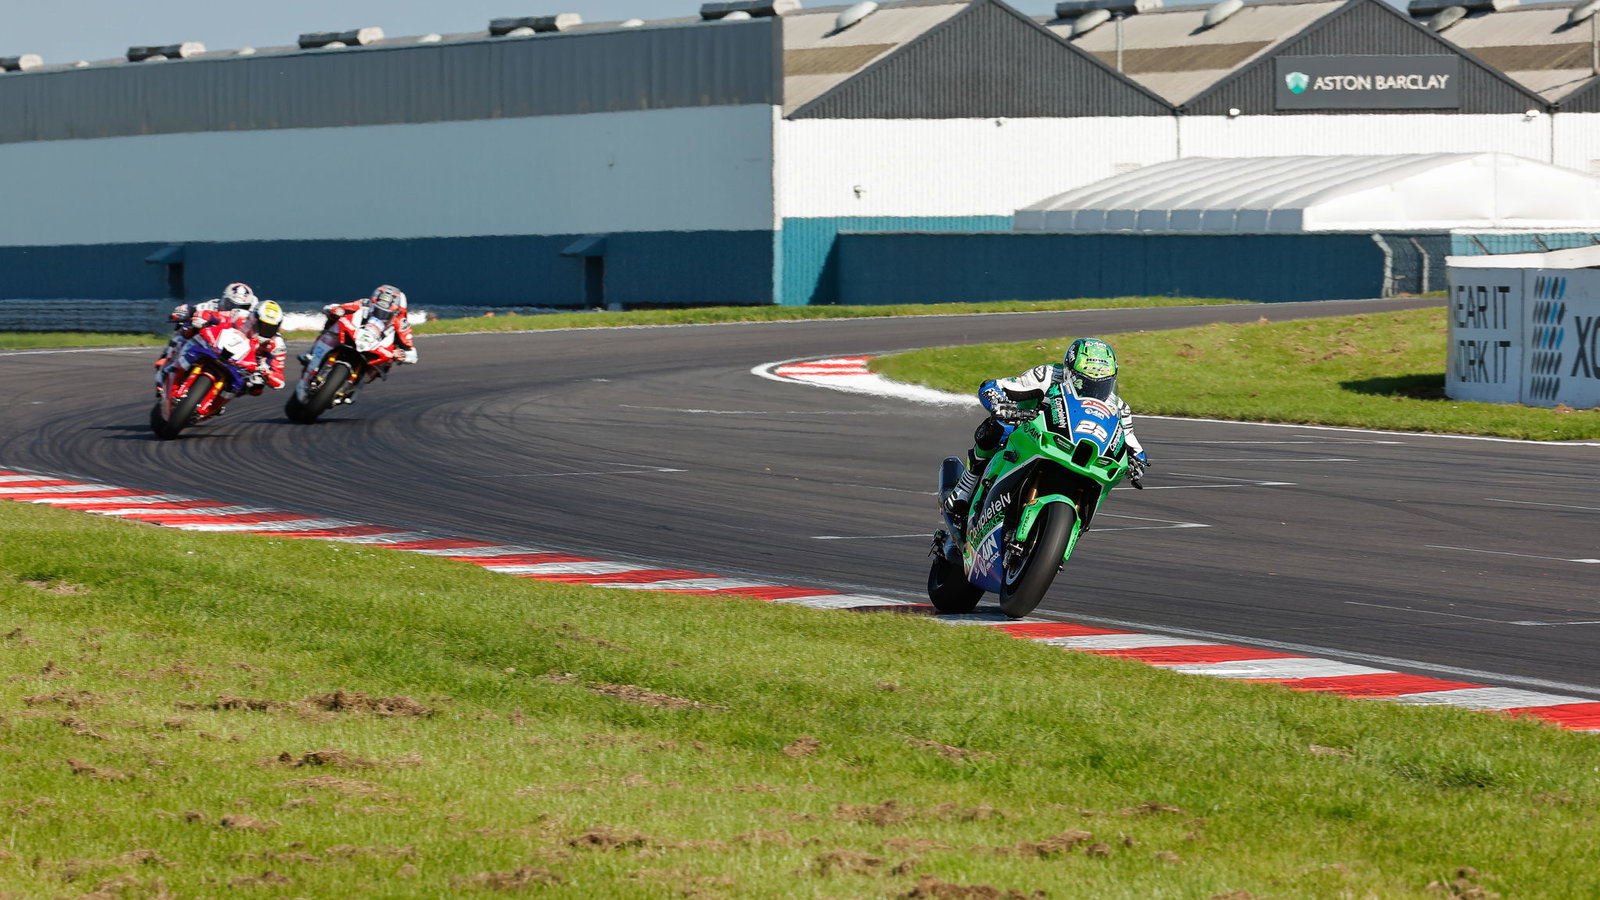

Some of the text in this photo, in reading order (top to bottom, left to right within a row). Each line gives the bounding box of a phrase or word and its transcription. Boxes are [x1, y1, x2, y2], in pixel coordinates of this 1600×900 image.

[1313, 74, 1450, 91] ASTON BARCLAY
[1448, 285, 1511, 330] EAR IT
[1455, 340, 1512, 384] ORK IT
[1073, 420, 1108, 444] 22
